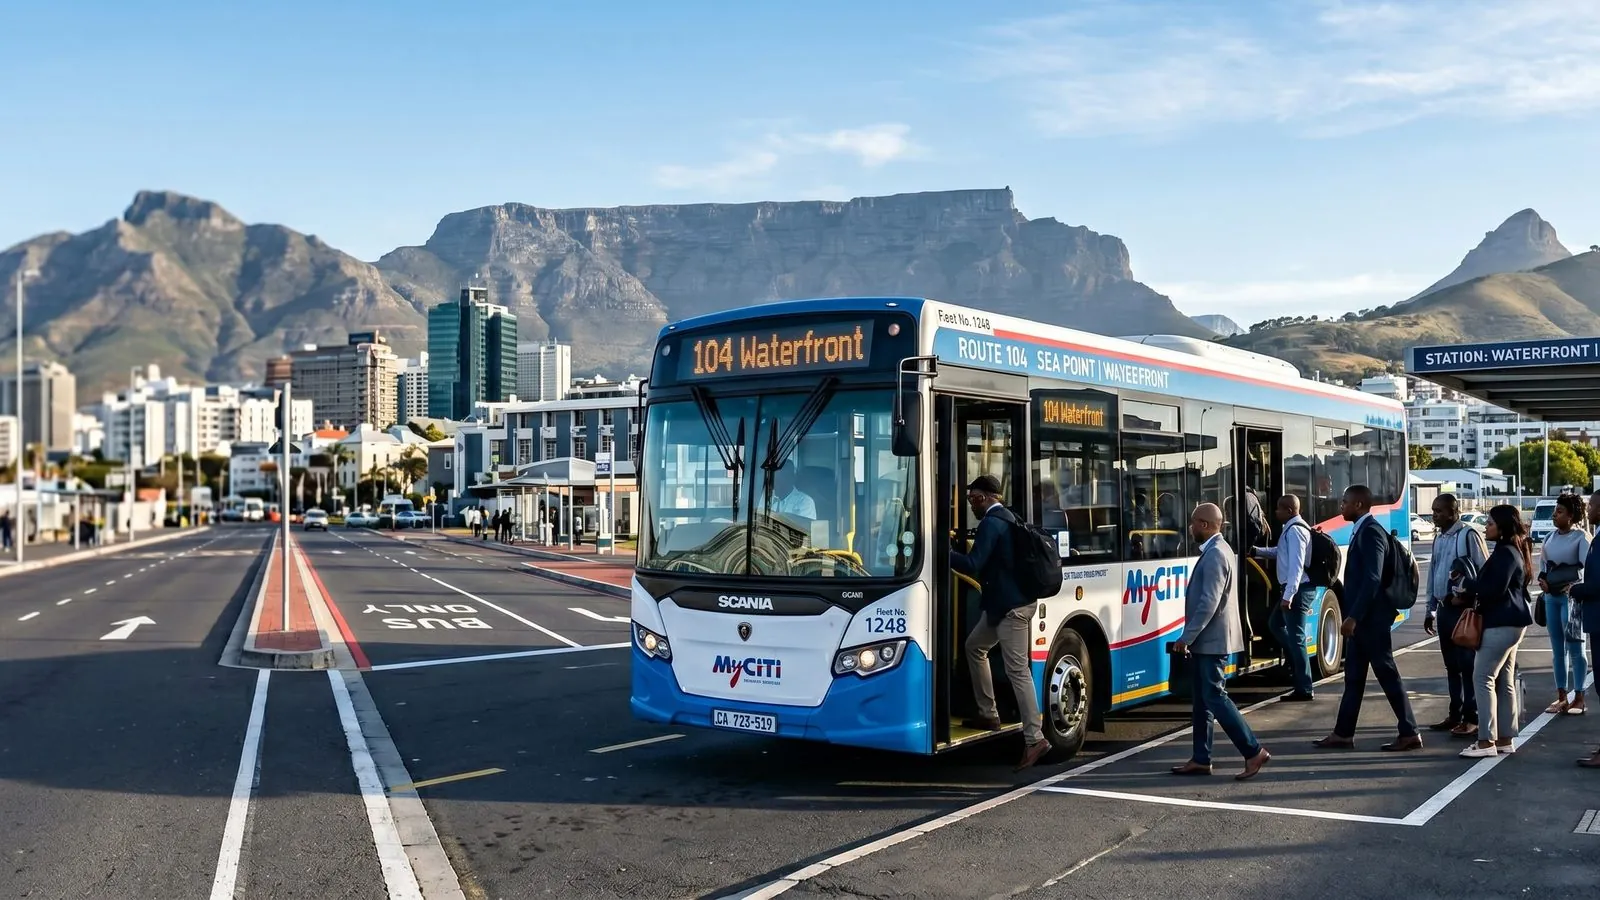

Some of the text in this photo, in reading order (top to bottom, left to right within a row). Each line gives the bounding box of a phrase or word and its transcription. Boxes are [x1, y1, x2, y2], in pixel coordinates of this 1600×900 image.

[938, 310, 990, 330] Feet No. 1248
[693, 324, 864, 375] 104 Waterfront
[958, 337, 1003, 365] ROUTE
[1006, 345, 1028, 368] 104
[1037, 350, 1060, 373] SEA
[1063, 355, 1095, 378] POINT
[1425, 350, 1489, 366] STATION:
[1491, 344, 1590, 361] WATERFRONT
[1060, 401, 1104, 427] Waterfront
[362, 604, 478, 614] ONLY
[718, 595, 774, 611] SCANIA
[876, 608, 893, 616] Fleet
[381, 617, 493, 630] BUS
[865, 617, 907, 633] 1248
[733, 714, 772, 731] 723-519
